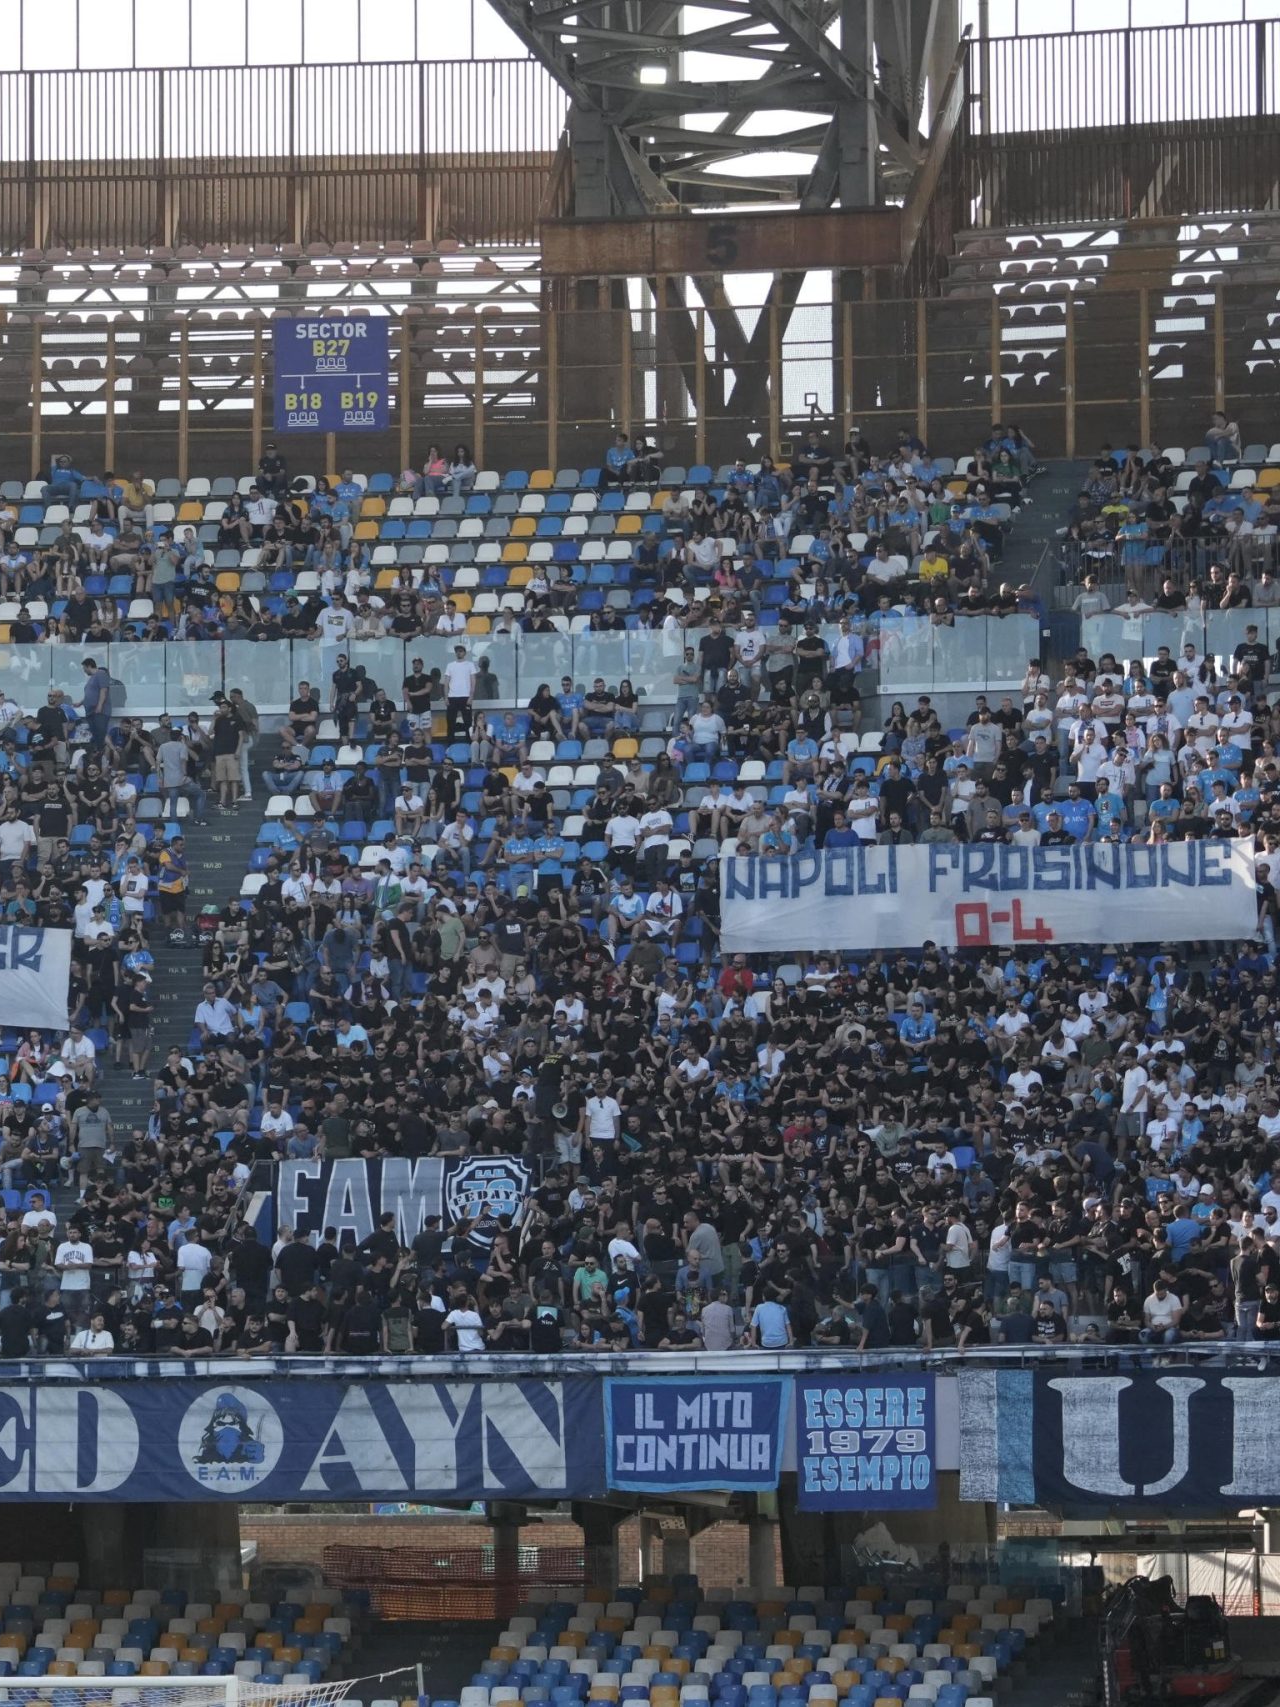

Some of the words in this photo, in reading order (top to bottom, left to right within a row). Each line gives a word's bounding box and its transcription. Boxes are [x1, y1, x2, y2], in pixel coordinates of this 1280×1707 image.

[706, 225, 738, 267] 5
[296, 323, 367, 338] SECTOR
[312, 340, 350, 356] B27
[285, 393, 322, 410] B18
[340, 392, 378, 409] B19
[725, 843, 899, 899] NAPOLI
[929, 838, 1233, 894] FROSINONE
[954, 899, 1053, 947] 0-4
[277, 1158, 444, 1250] EAM
[634, 1393, 665, 1430] IL
[677, 1391, 752, 1429] MITO
[804, 1386, 927, 1428] ESSERE
[300, 1382, 568, 1492] AYN
[615, 1432, 771, 1472] CONTINUA
[805, 1429, 927, 1455] 1979
[197, 1466, 260, 1481] E.A.M.
[803, 1454, 931, 1493] ESEMPIO
